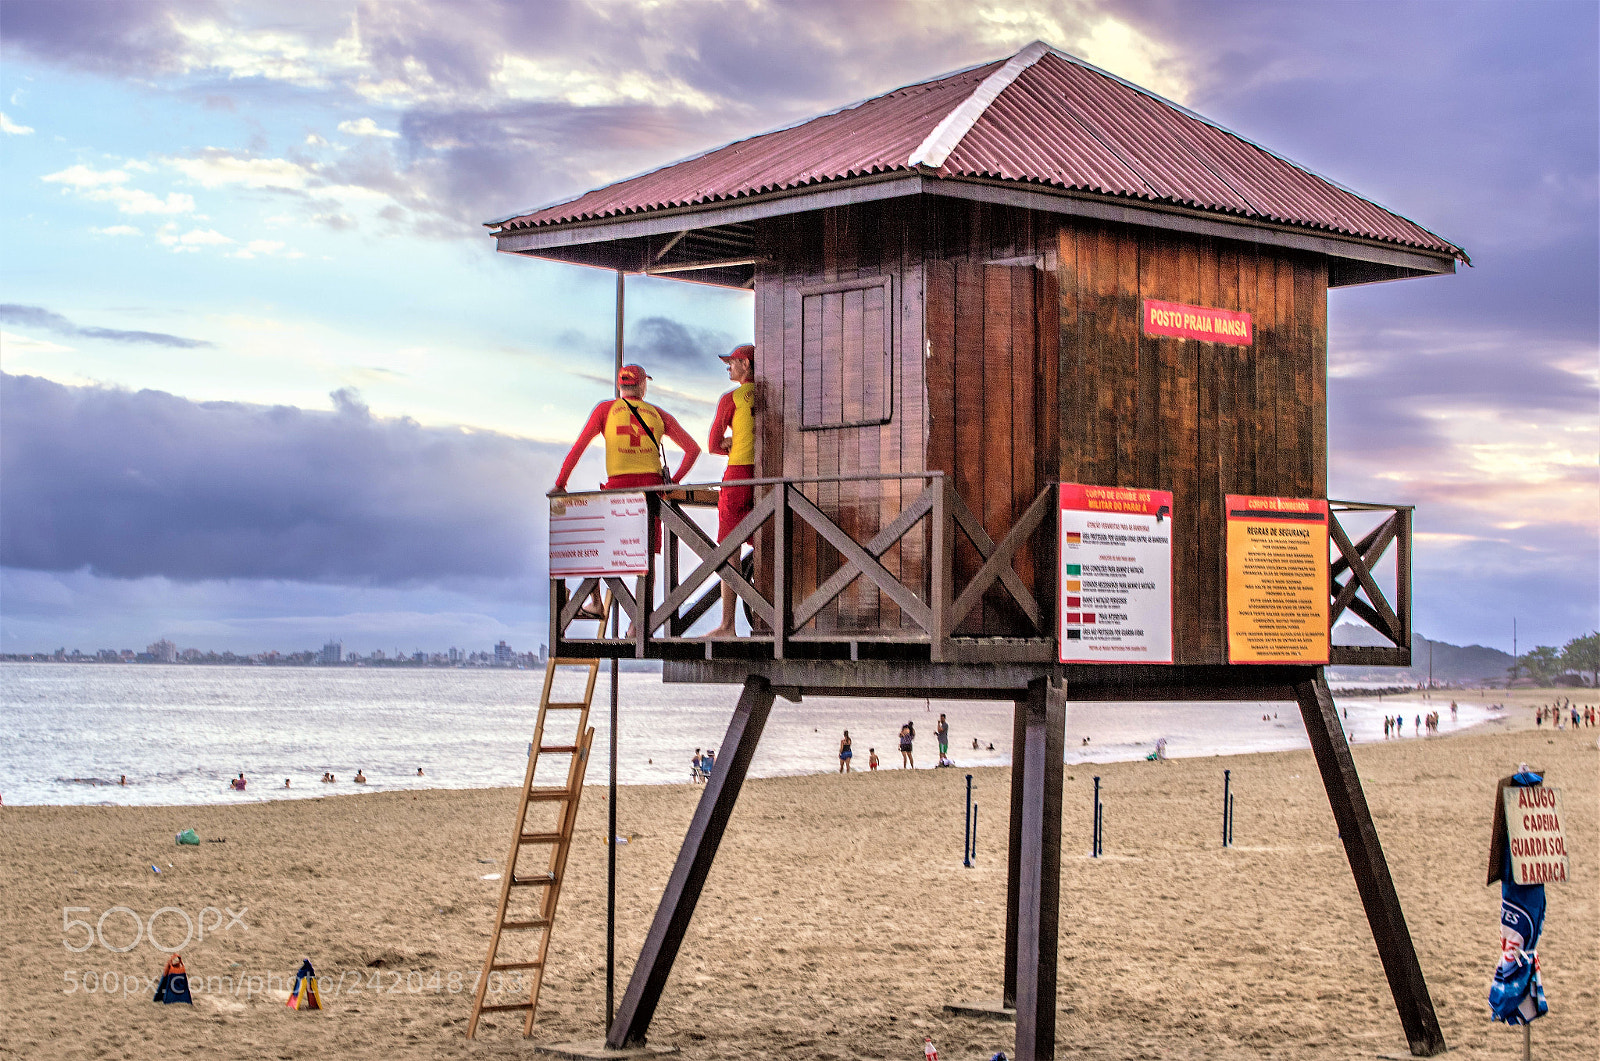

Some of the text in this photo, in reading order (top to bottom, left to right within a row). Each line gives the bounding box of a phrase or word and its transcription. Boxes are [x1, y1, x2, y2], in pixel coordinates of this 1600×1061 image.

[1150, 308, 1247, 337] POSTO PRAIA MANSA
[1086, 489, 1150, 502] CORPO DE BOMBEROS
[1088, 499, 1113, 510] MILITAR
[1114, 501, 1122, 510] DO
[1248, 500, 1309, 511] CORPO DE BOMBEIROS
[1247, 526, 1310, 538] REGRAS DE SEGURANÇA
[1519, 787, 1556, 809] ALUGO
[1523, 814, 1560, 832] CADEIRA
[1521, 862, 1566, 882] BARRACA
